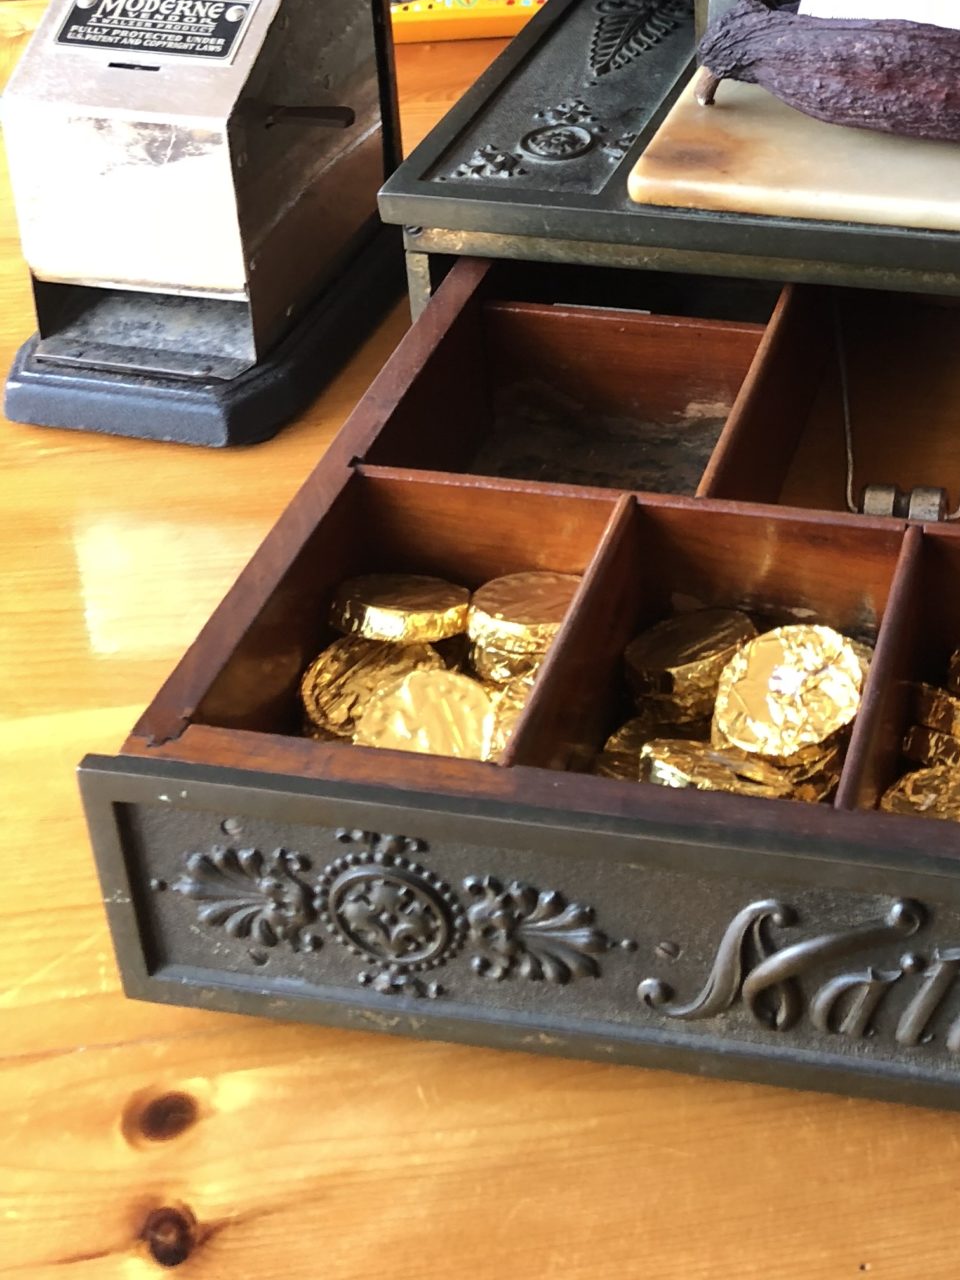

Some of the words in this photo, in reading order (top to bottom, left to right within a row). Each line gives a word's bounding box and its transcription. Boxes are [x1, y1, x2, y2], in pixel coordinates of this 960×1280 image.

[69, 24, 107, 35] FULLY
[112, 28, 184, 43] PROTECTED
[187, 35, 225, 46] UNDER
[120, 36, 143, 46] AND
[143, 38, 195, 51] COPYRIGHT
[195, 44, 222, 53] LAWS
